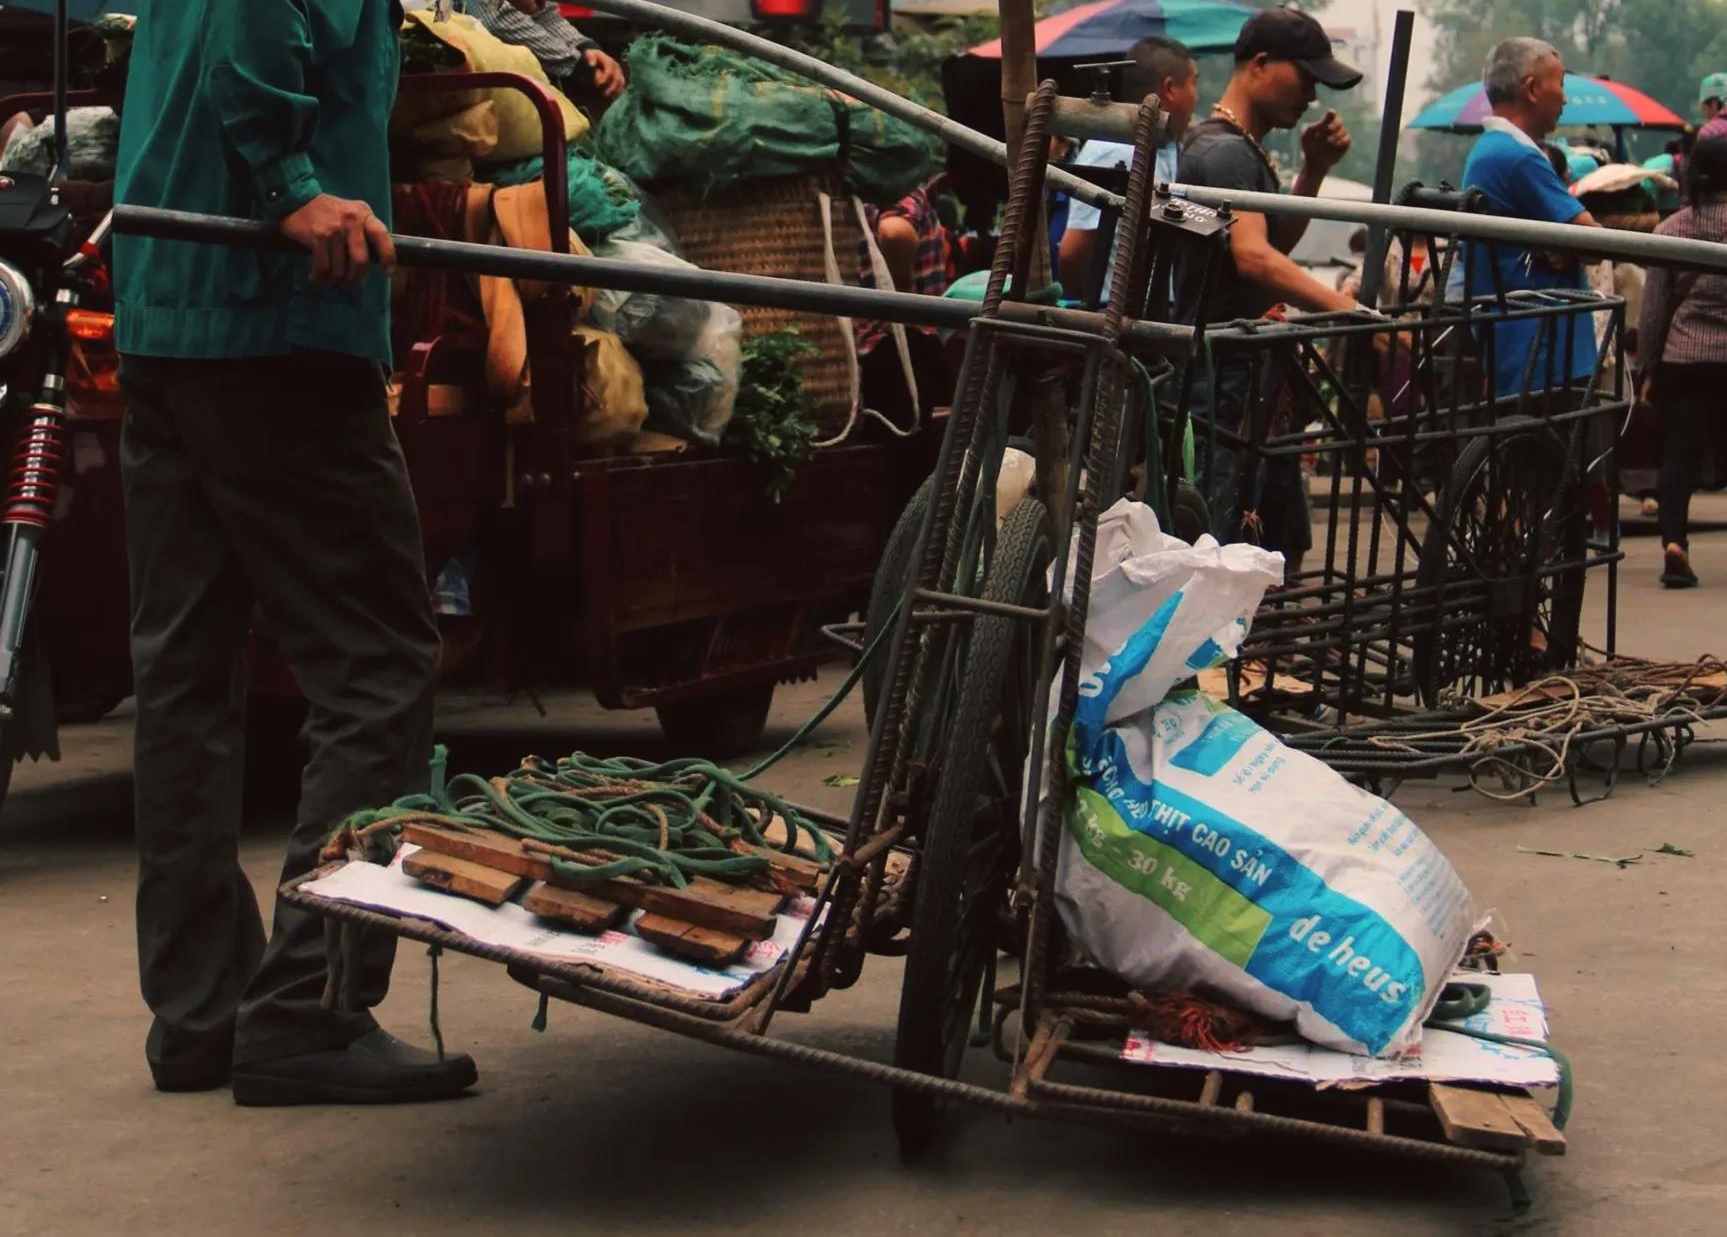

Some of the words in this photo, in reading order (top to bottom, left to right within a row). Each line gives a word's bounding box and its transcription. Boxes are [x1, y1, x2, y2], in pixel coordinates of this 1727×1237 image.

[1127, 849, 1159, 875] 30
[1160, 866, 1194, 902] kg
[1191, 823, 1232, 858] CAO
[1230, 849, 1273, 887] SẢN
[1288, 914, 1332, 953] de
[1328, 936, 1409, 1003] heus
